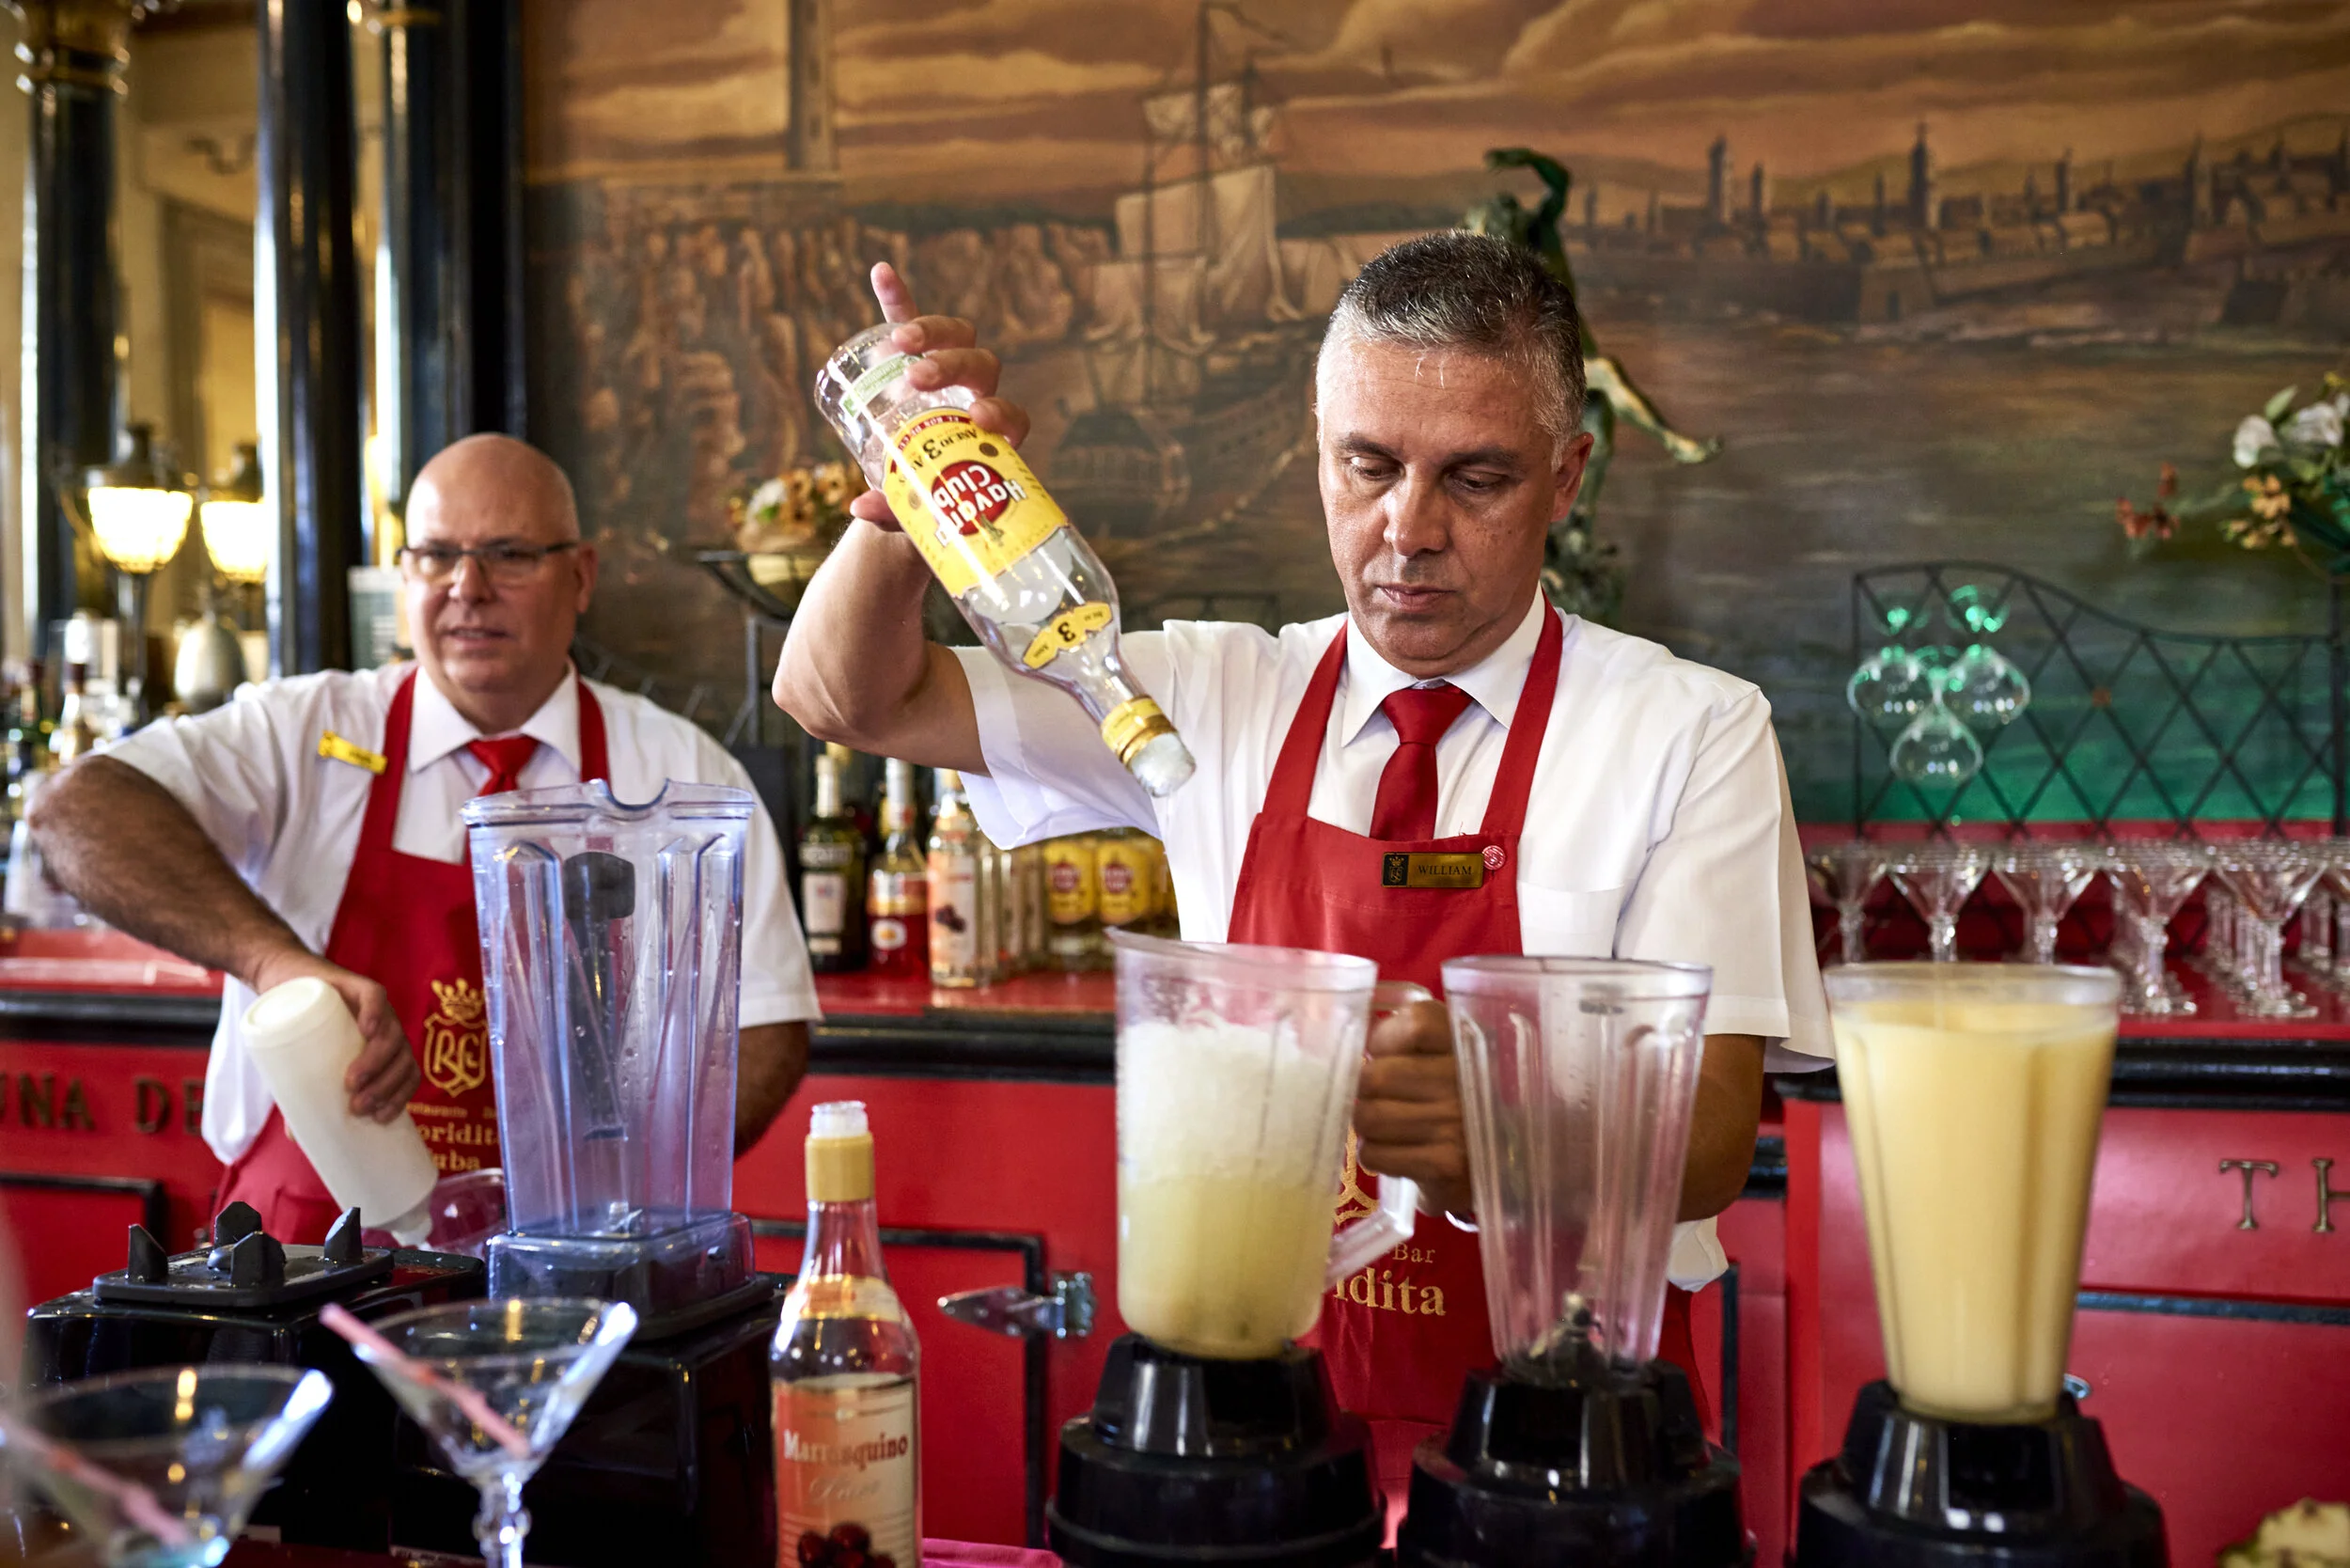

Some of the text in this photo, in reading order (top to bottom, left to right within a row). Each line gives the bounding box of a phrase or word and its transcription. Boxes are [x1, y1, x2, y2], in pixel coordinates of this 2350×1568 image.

[922, 438, 943, 461] 3
[932, 464, 992, 510] Club
[1058, 621, 1076, 642] 3
[1418, 865, 1473, 875] WILLIAM
[418, 1121, 497, 1146] oridit
[432, 1149, 480, 1171] uba
[1393, 1242, 1435, 1263] Bar
